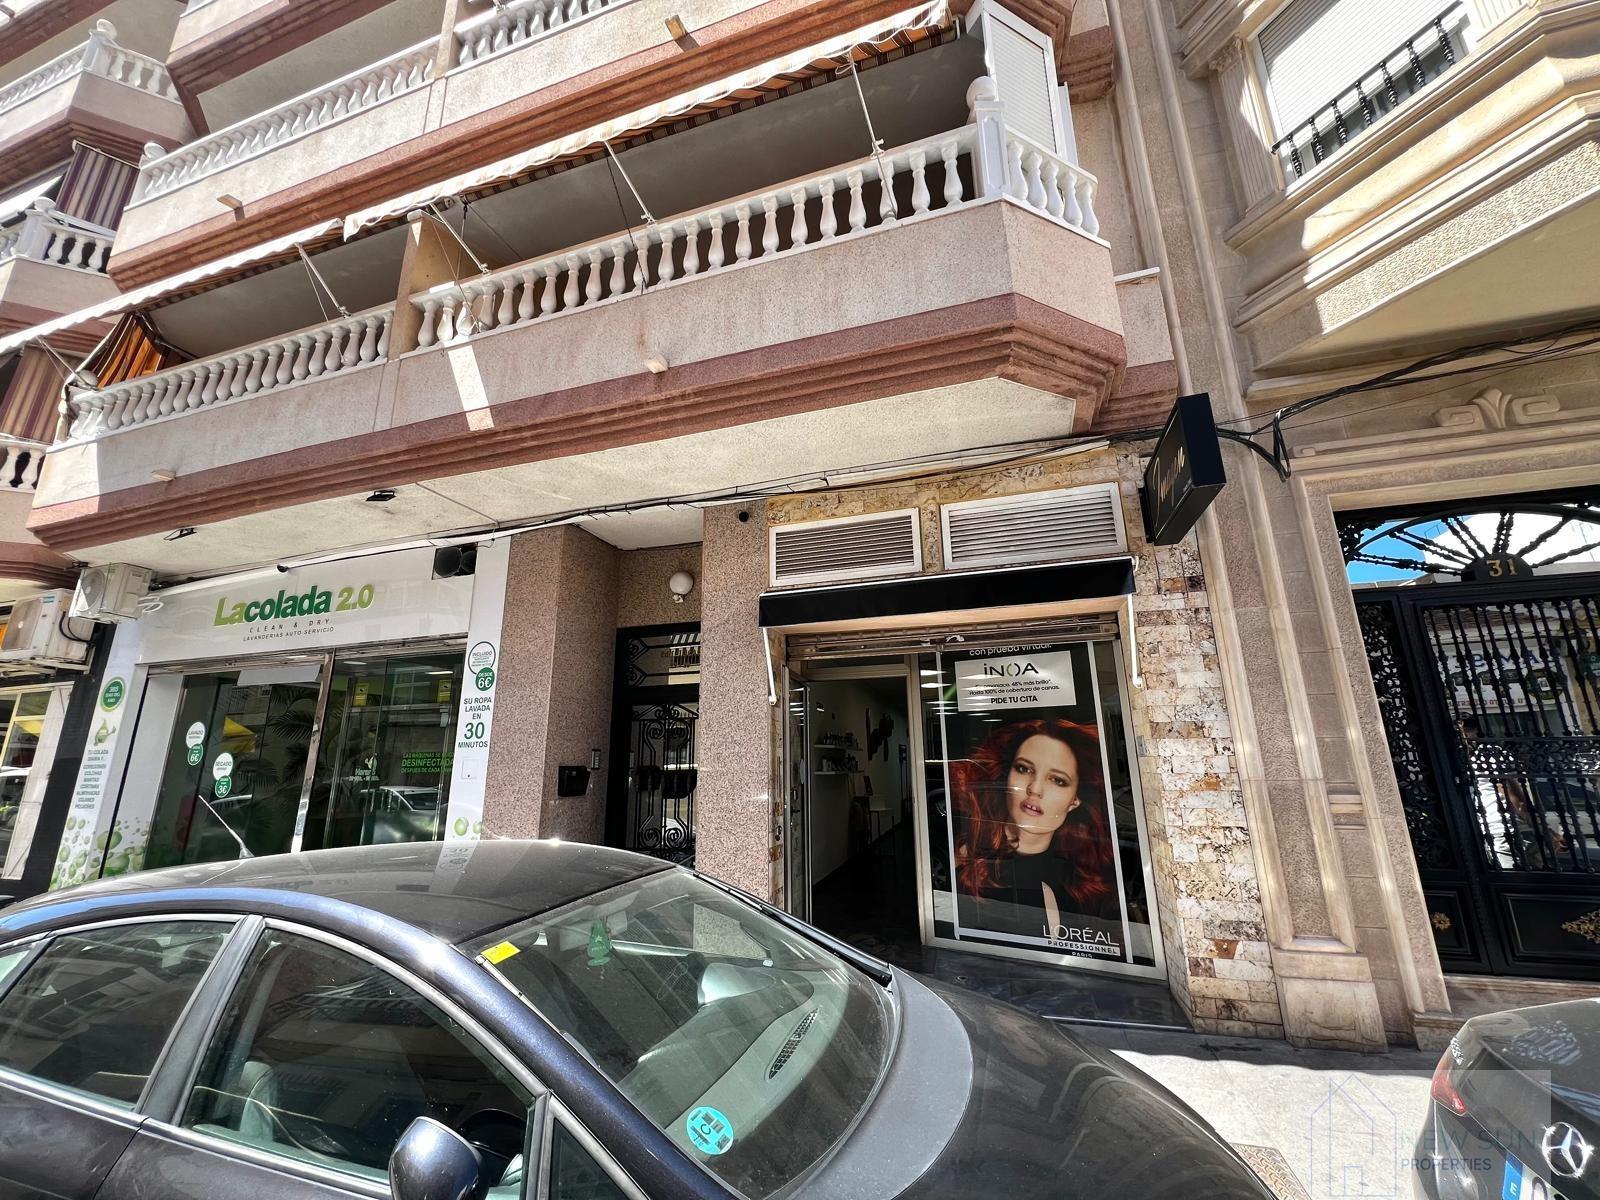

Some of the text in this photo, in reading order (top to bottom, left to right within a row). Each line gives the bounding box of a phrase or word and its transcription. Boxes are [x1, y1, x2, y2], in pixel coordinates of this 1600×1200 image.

[1486, 559, 1518, 577] 31
[213, 583, 375, 626] Lacolada 2.0
[250, 625, 283, 633] CLEAN
[304, 627, 334, 635] SERVICIO
[987, 645, 1020, 655] prueba
[478, 677, 492, 688] 6€
[1020, 695, 1038, 703] CITA
[464, 722, 485, 739] 30
[191, 753, 200, 762] 6€
[218, 785, 227, 794] 3€
[1048, 940, 1117, 954] PROFESSIONNEL
[700, 1124, 712, 1135] C
